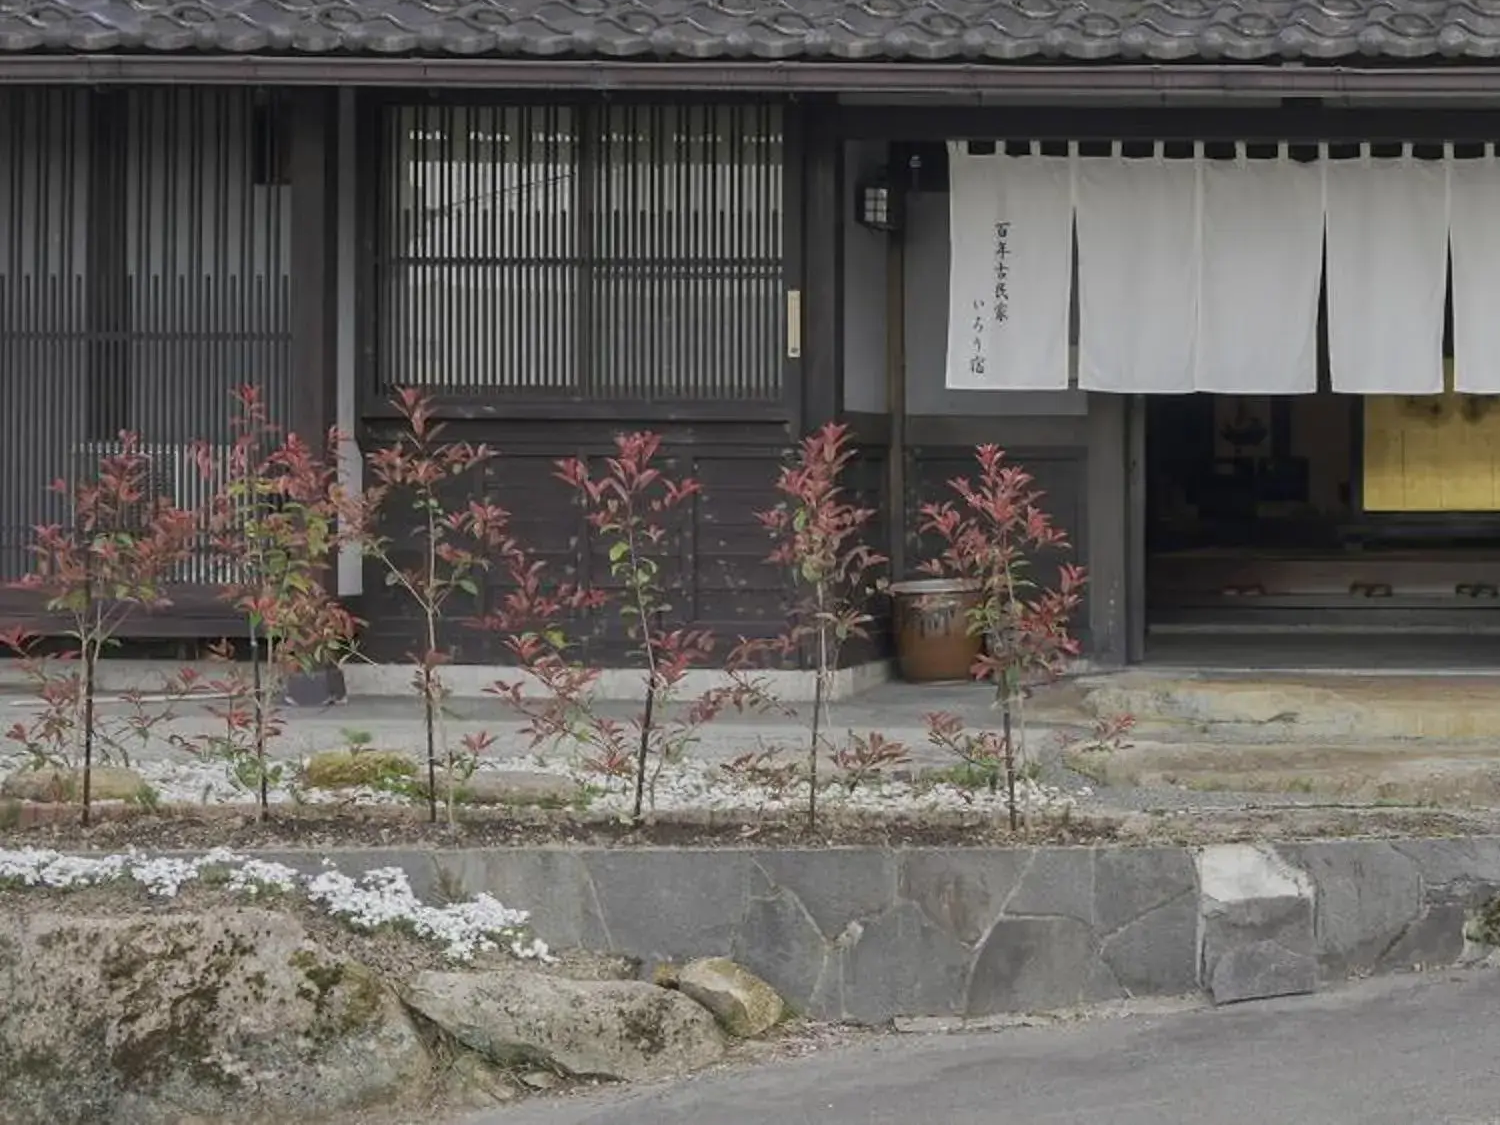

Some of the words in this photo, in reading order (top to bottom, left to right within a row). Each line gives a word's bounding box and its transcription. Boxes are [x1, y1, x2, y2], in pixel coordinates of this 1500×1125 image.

[994, 221, 1011, 322] 百年古民家
